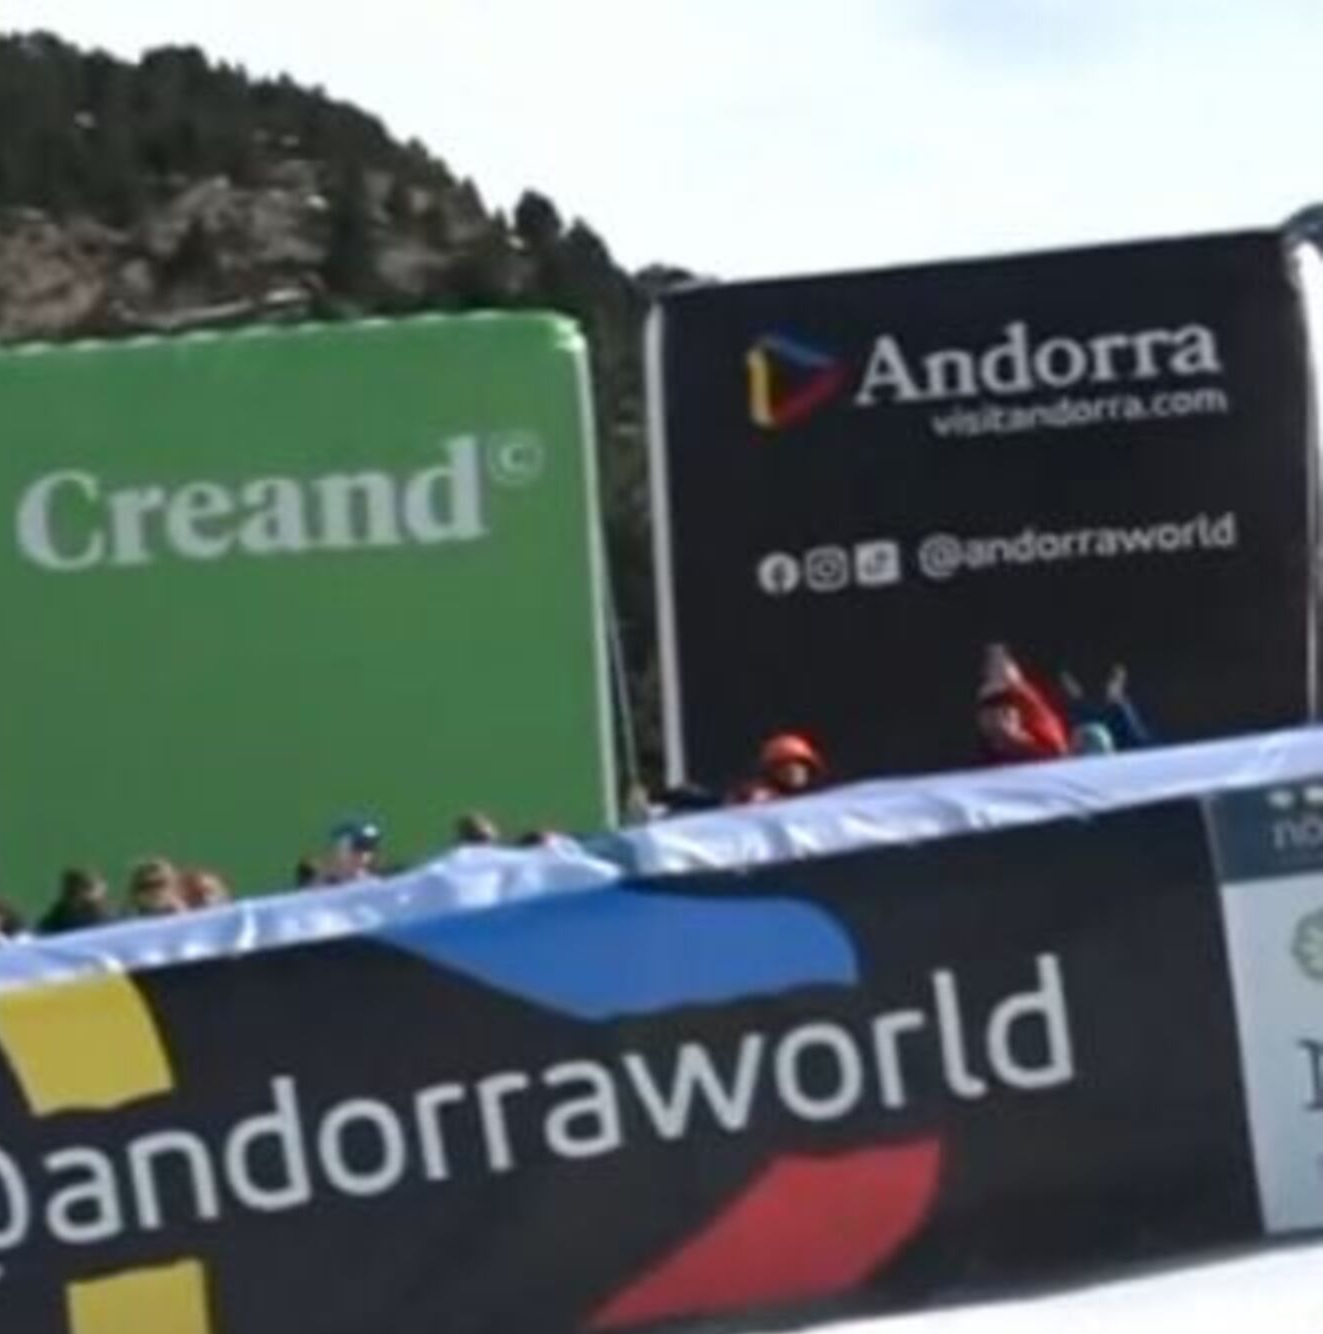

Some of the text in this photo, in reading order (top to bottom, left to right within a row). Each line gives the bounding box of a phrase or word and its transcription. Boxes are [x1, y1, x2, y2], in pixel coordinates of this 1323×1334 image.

[855, 321, 1222, 405] Andorra
[932, 386, 1229, 437] visitandorra.com
[919, 512, 1240, 580] @andorraworld
